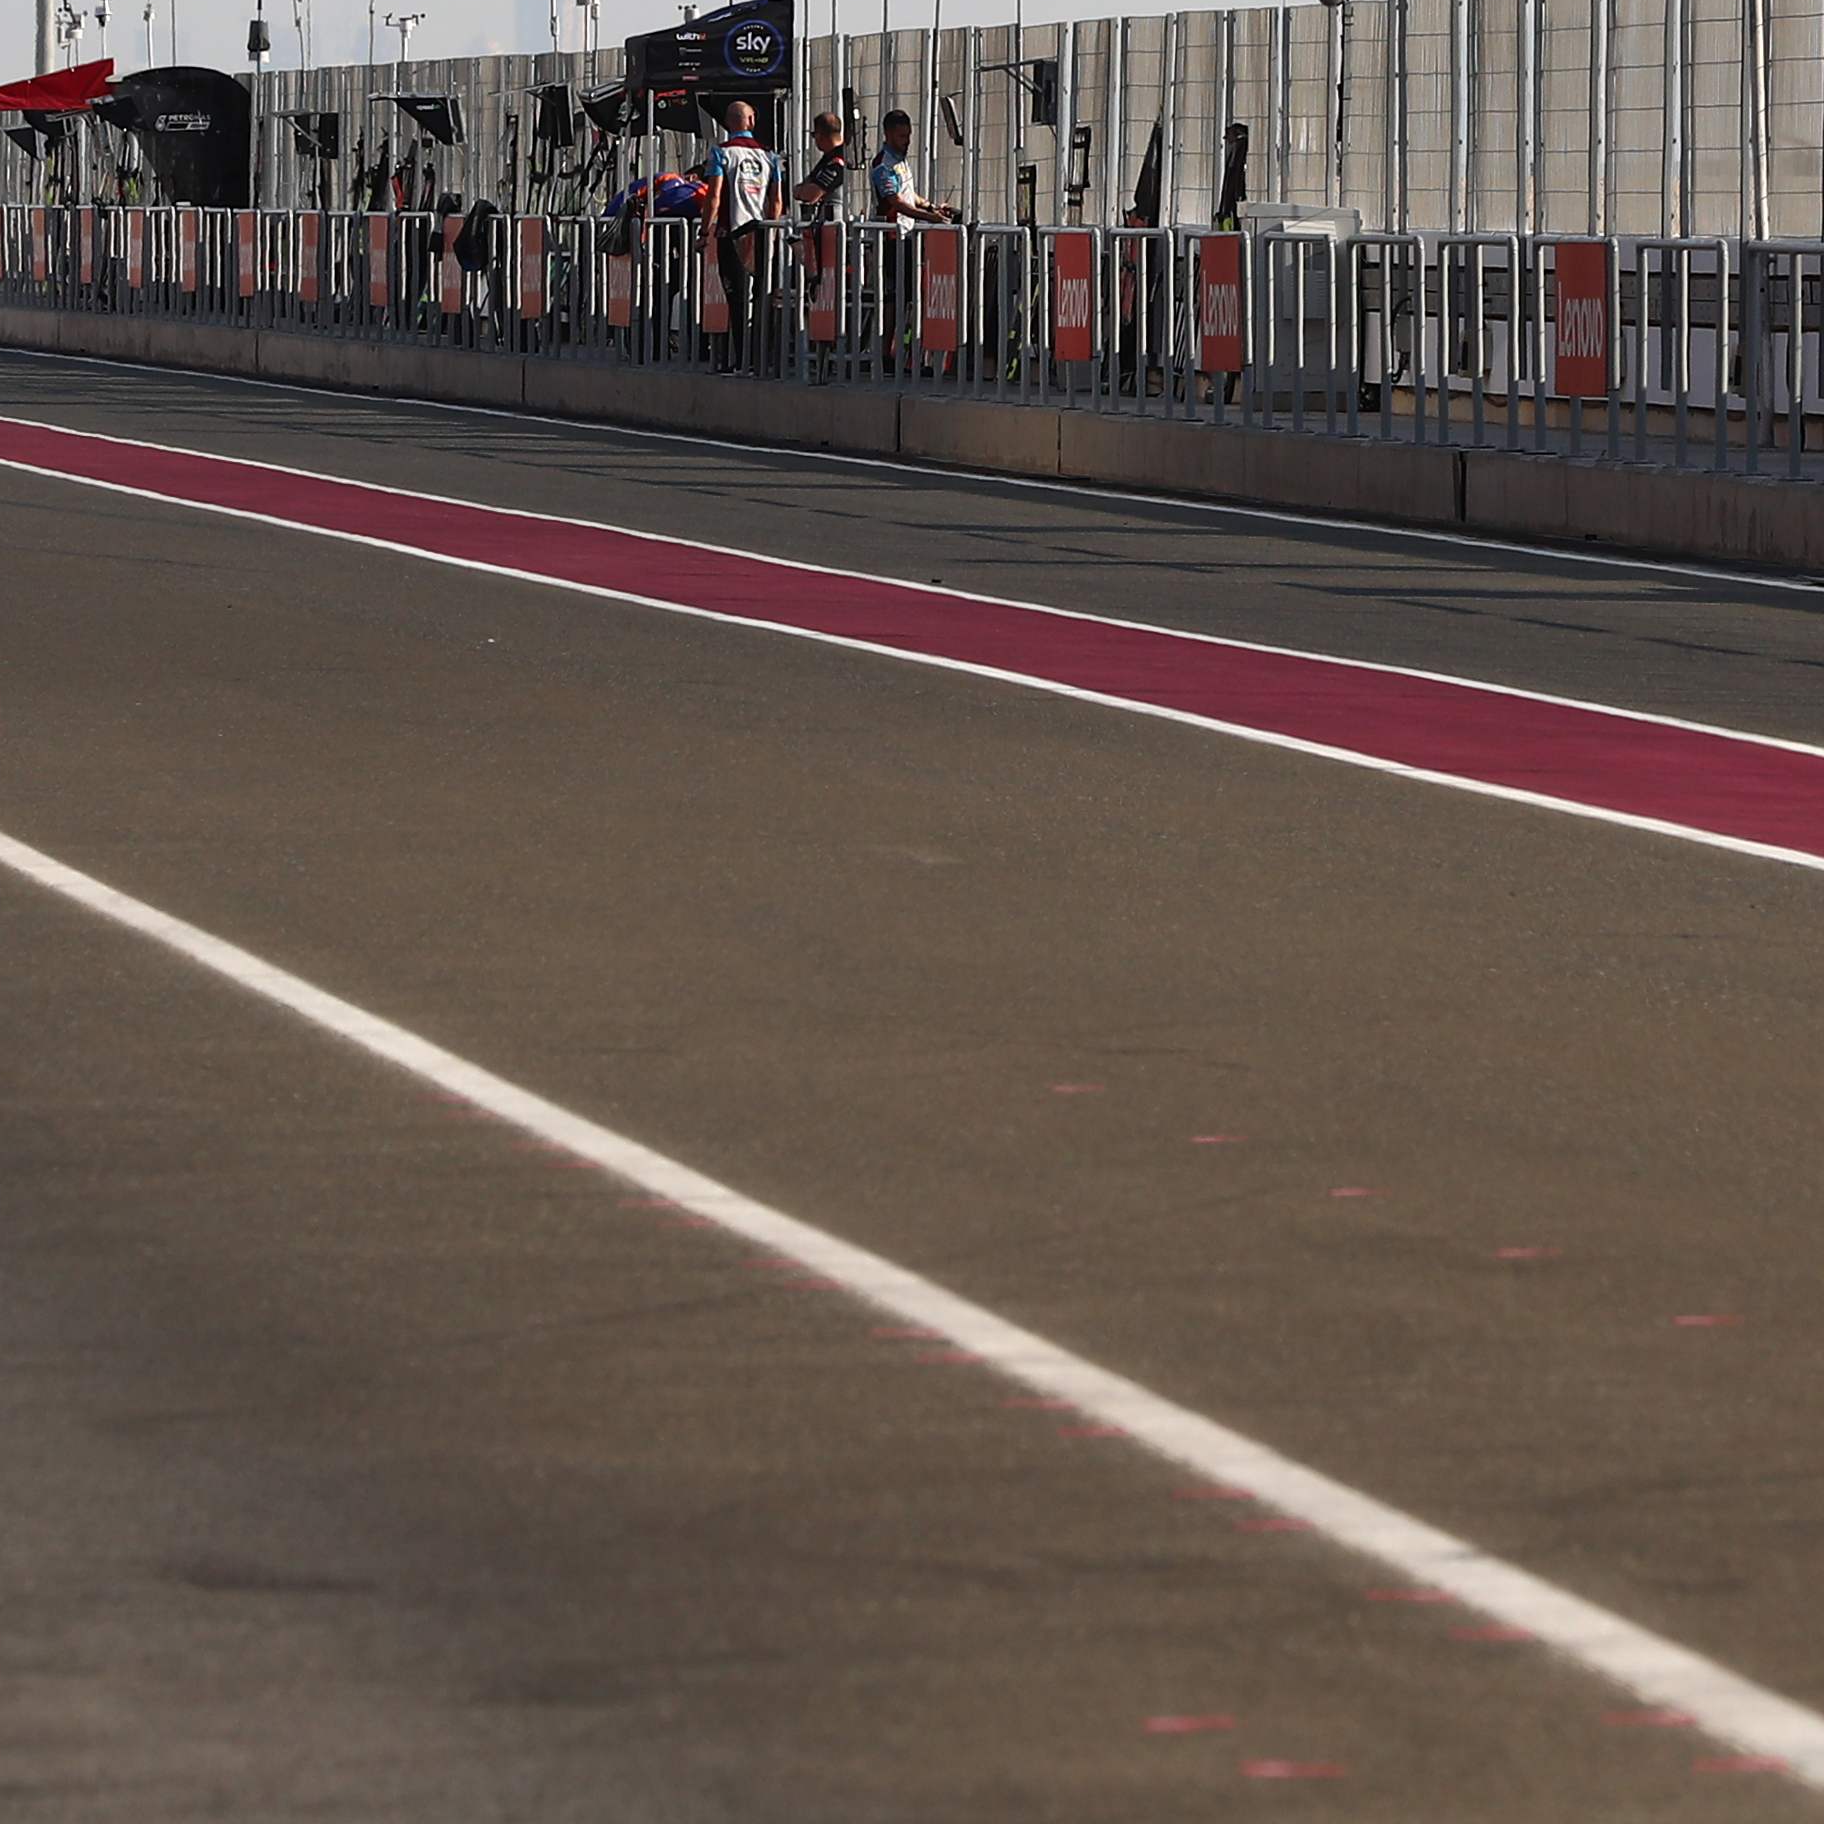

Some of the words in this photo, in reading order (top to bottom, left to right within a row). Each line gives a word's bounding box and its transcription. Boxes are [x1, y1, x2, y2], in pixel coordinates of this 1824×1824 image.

[736, 32, 771, 55] sky
[1057, 265, 1089, 328] Lenovo
[1203, 270, 1239, 337] Lenovo
[1556, 280, 1604, 358] Lenovo
